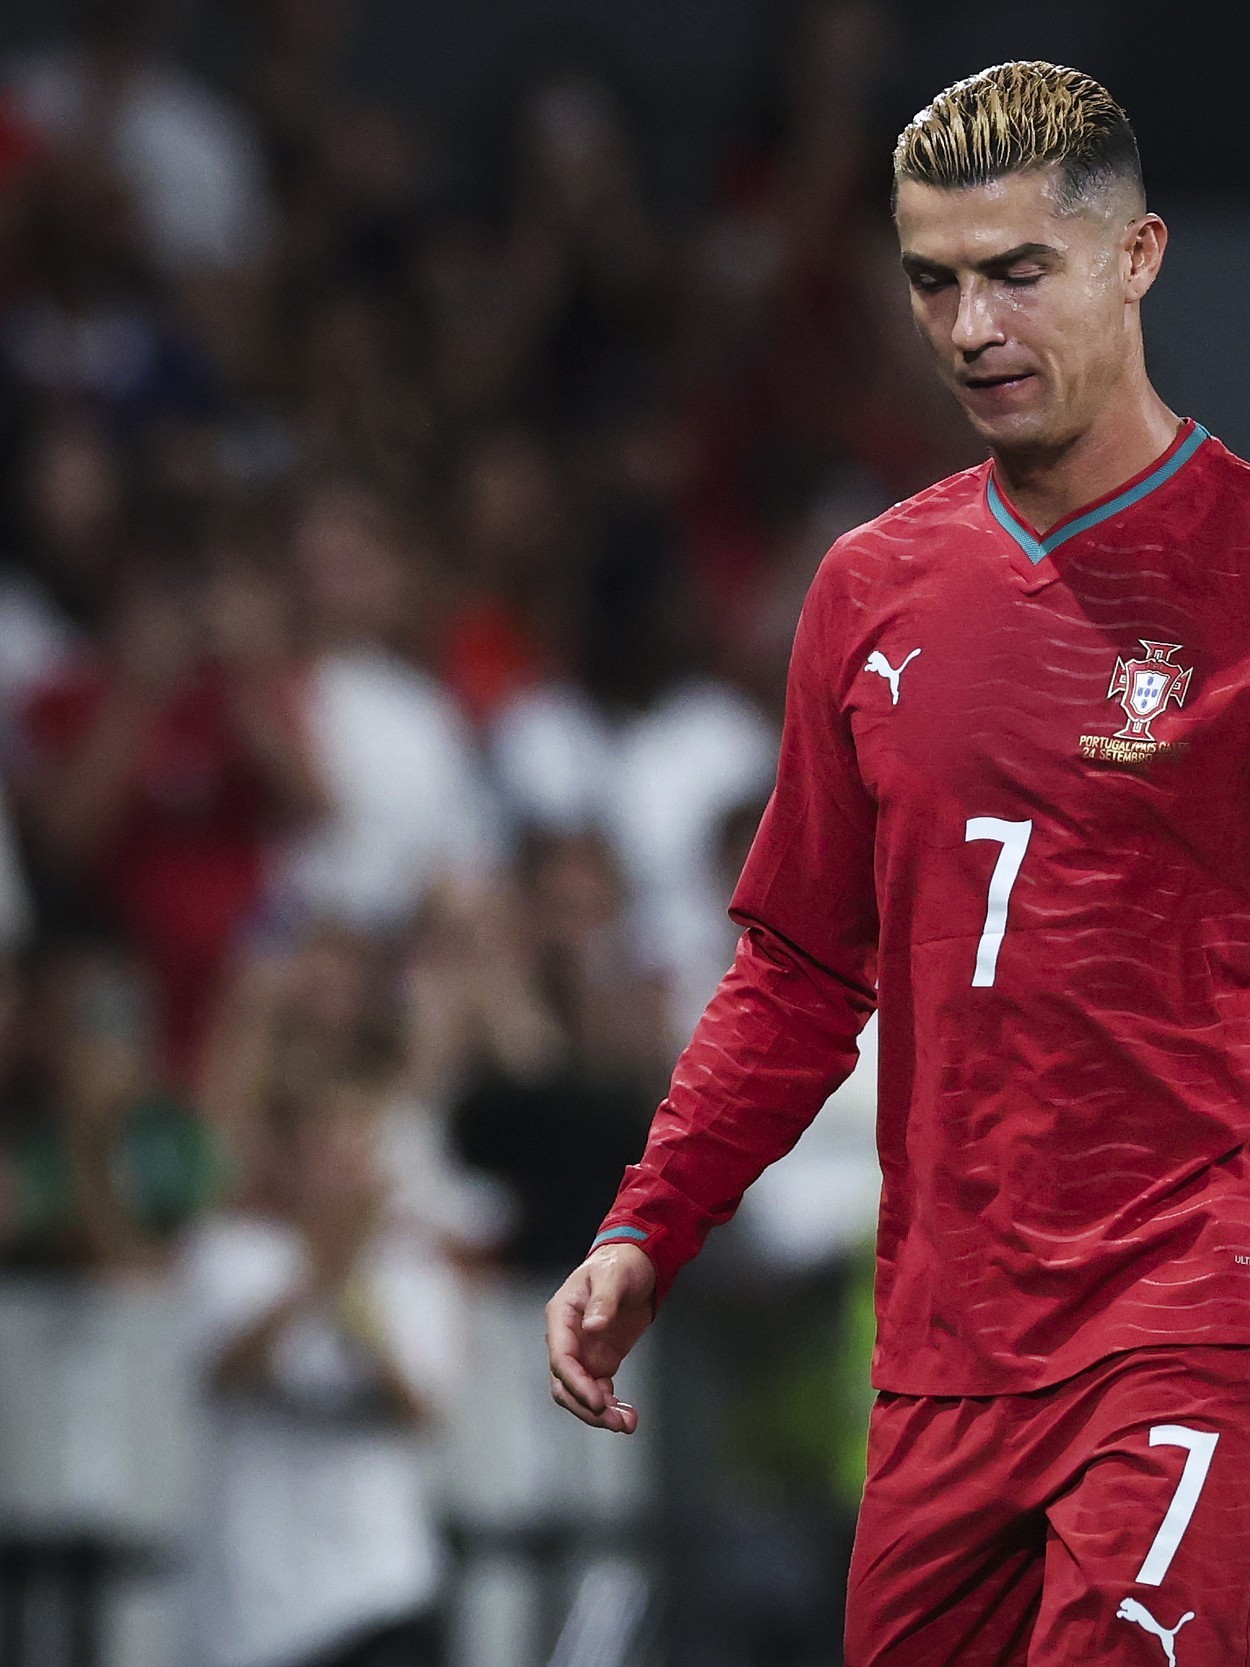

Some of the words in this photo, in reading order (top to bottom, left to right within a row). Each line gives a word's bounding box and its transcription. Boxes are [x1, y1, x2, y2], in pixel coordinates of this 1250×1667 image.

[1082, 746, 1095, 759] 24
[1100, 748, 1153, 763] SETEMBRO
[964, 816, 1032, 988] 7
[1134, 1424, 1220, 1587] 7
